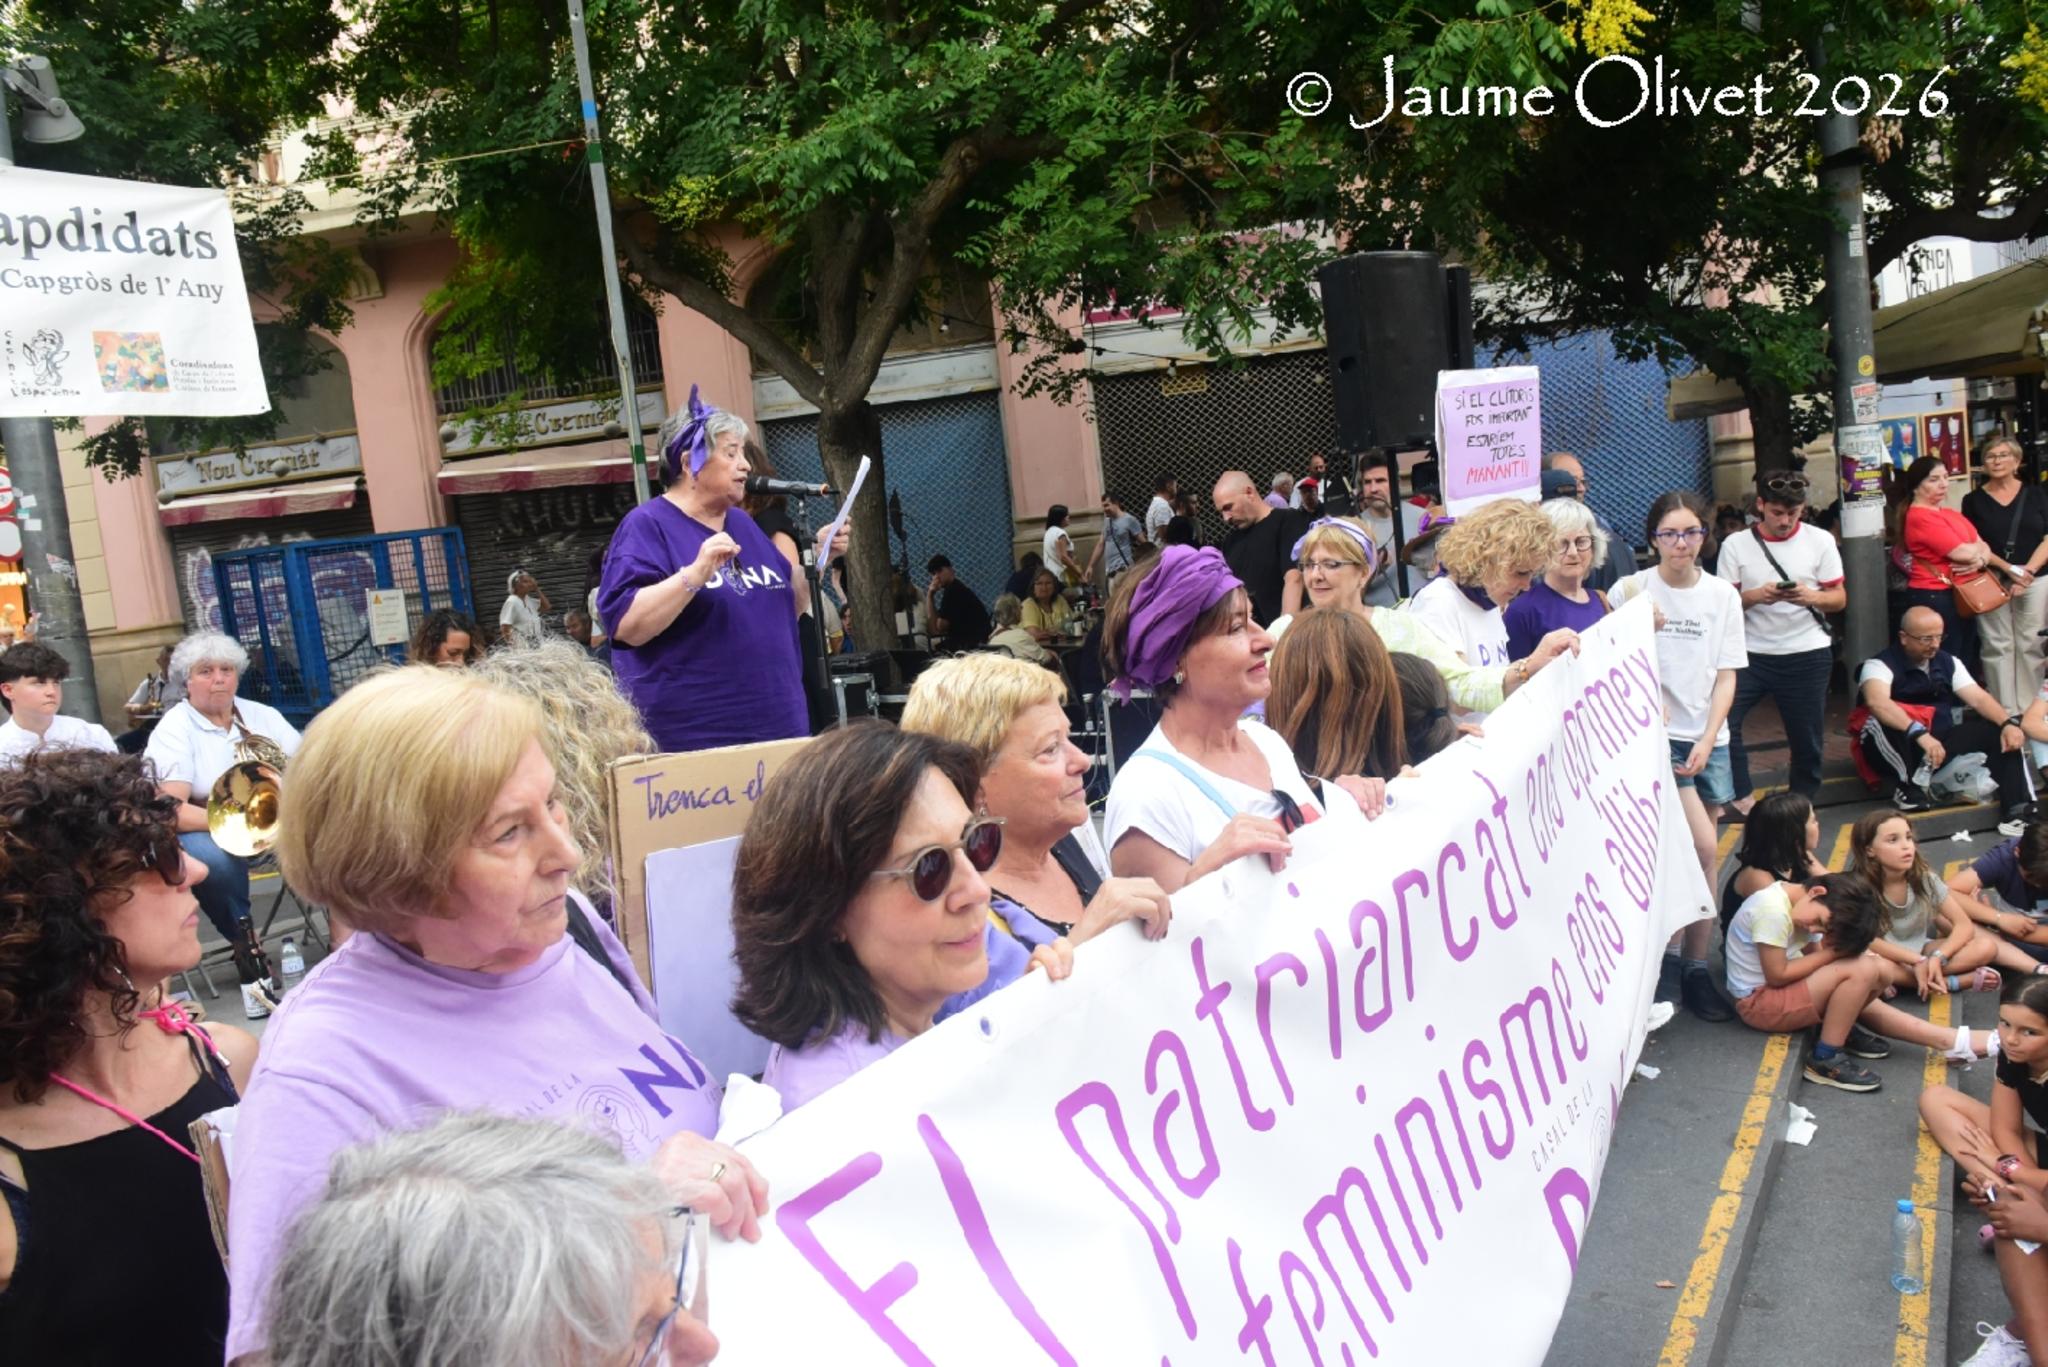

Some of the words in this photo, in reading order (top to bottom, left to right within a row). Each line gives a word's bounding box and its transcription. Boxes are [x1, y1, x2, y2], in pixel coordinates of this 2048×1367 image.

[0, 268, 113, 295] Capgròs
[120, 273, 147, 295] de
[1470, 393, 1485, 409] EL
[1465, 413, 1484, 428] FOS
[196, 460, 236, 484] Nou
[633, 772, 736, 820] Trenca
[741, 760, 765, 801] el
[1567, 872, 1626, 1006] ens
[1055, 768, 1532, 1341] patriarcat
[542, 1083, 564, 1105] DE
[562, 1071, 583, 1091] LA
[1566, 1096, 1580, 1126] DE
